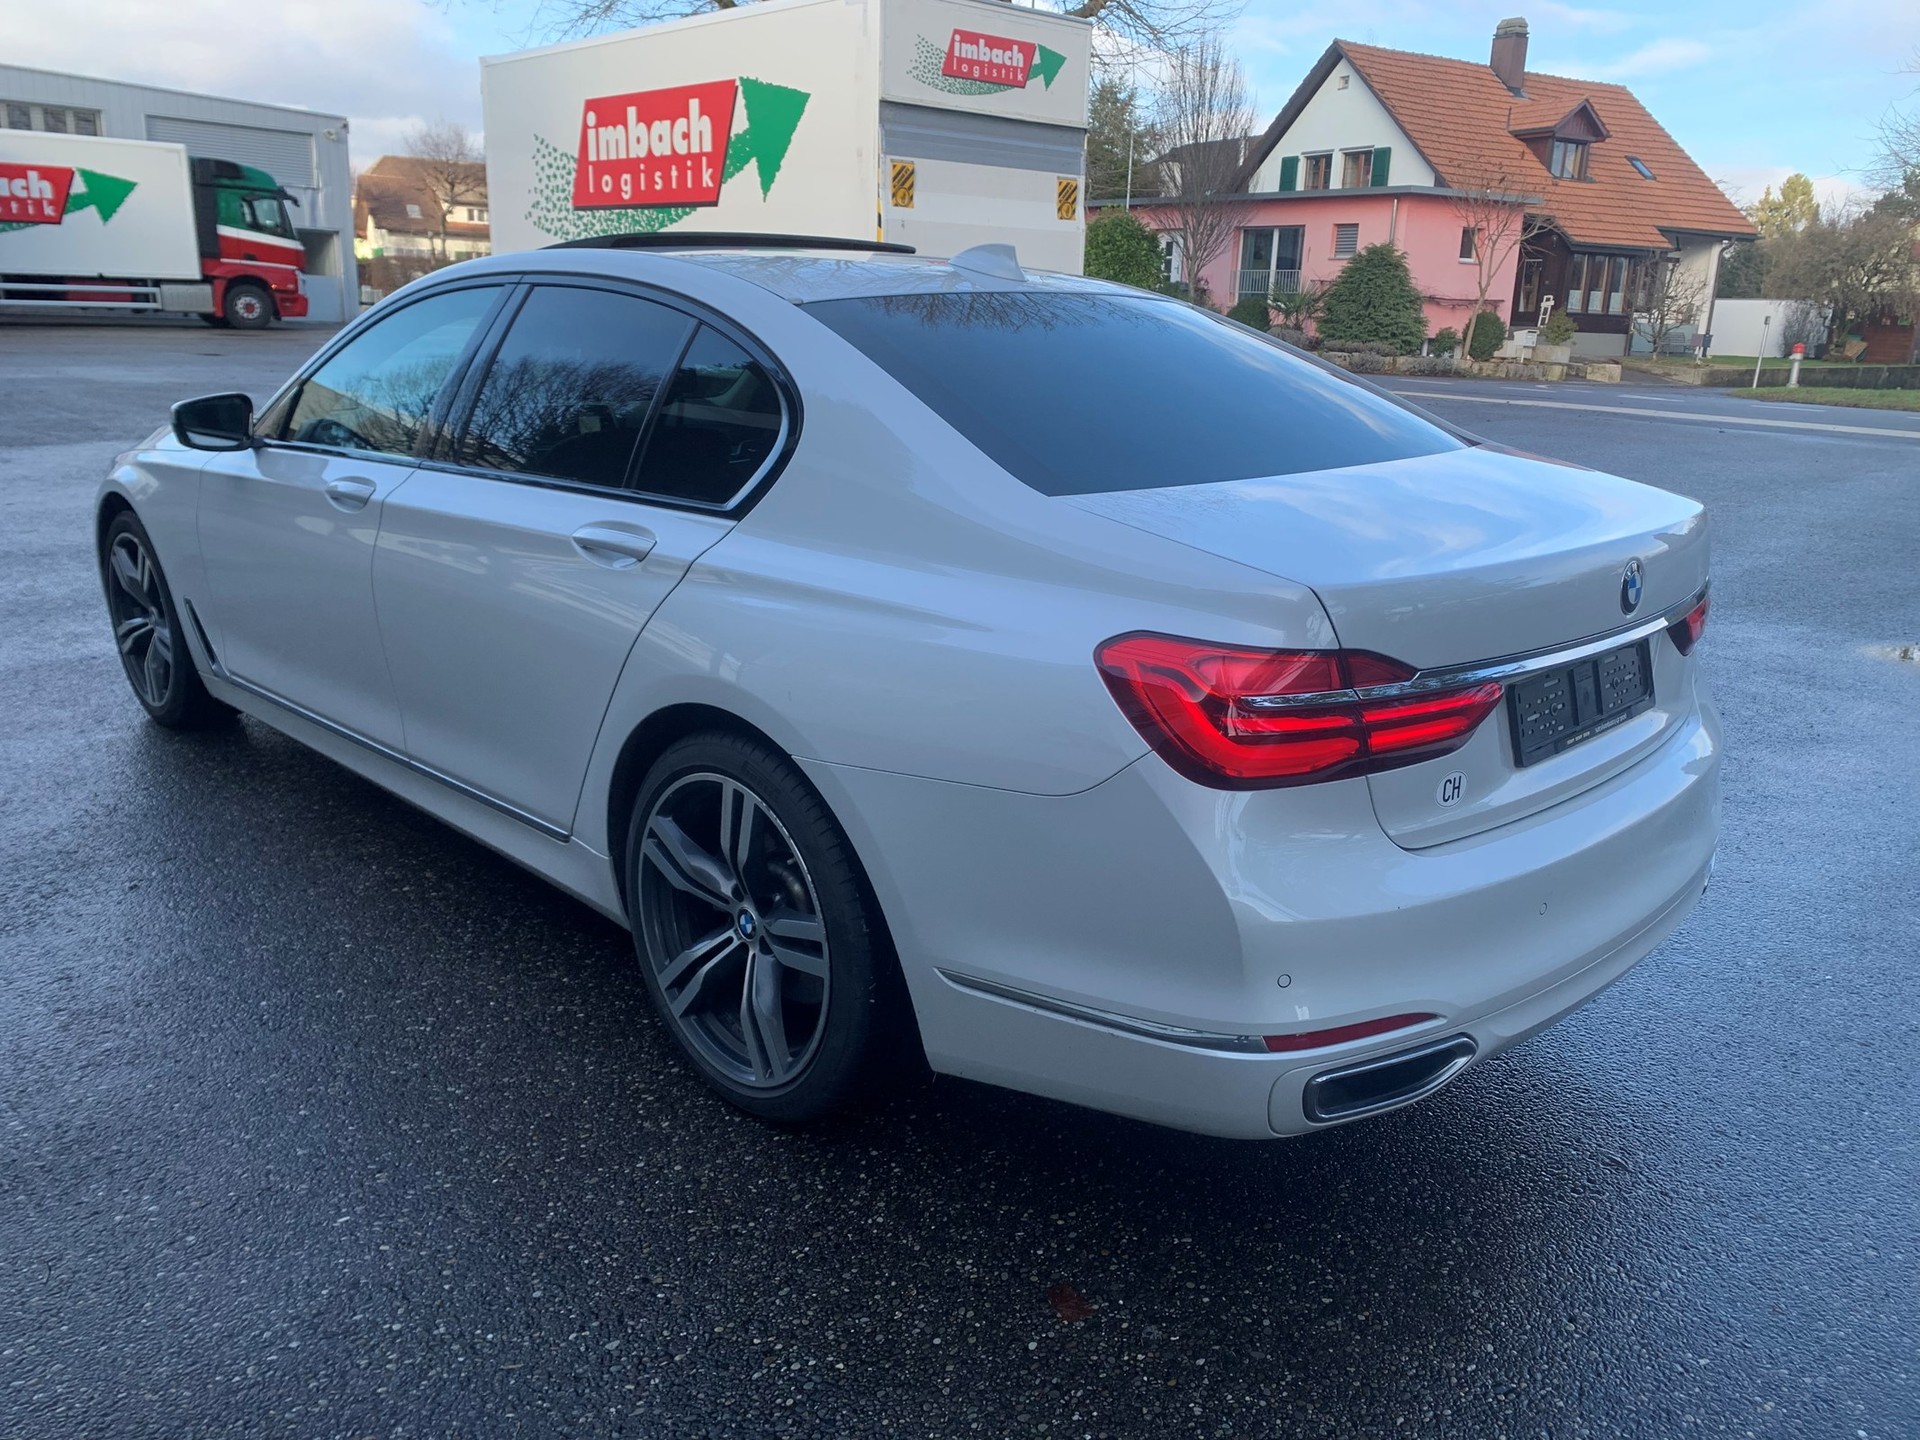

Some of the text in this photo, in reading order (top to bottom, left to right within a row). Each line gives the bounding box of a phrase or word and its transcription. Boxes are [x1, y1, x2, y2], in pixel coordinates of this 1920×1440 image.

[954, 34, 1024, 68] imbach
[953, 57, 1024, 81] logistik
[586, 98, 713, 161] imbach
[588, 156, 714, 200] logistik
[1442, 775, 1462, 803] CH
